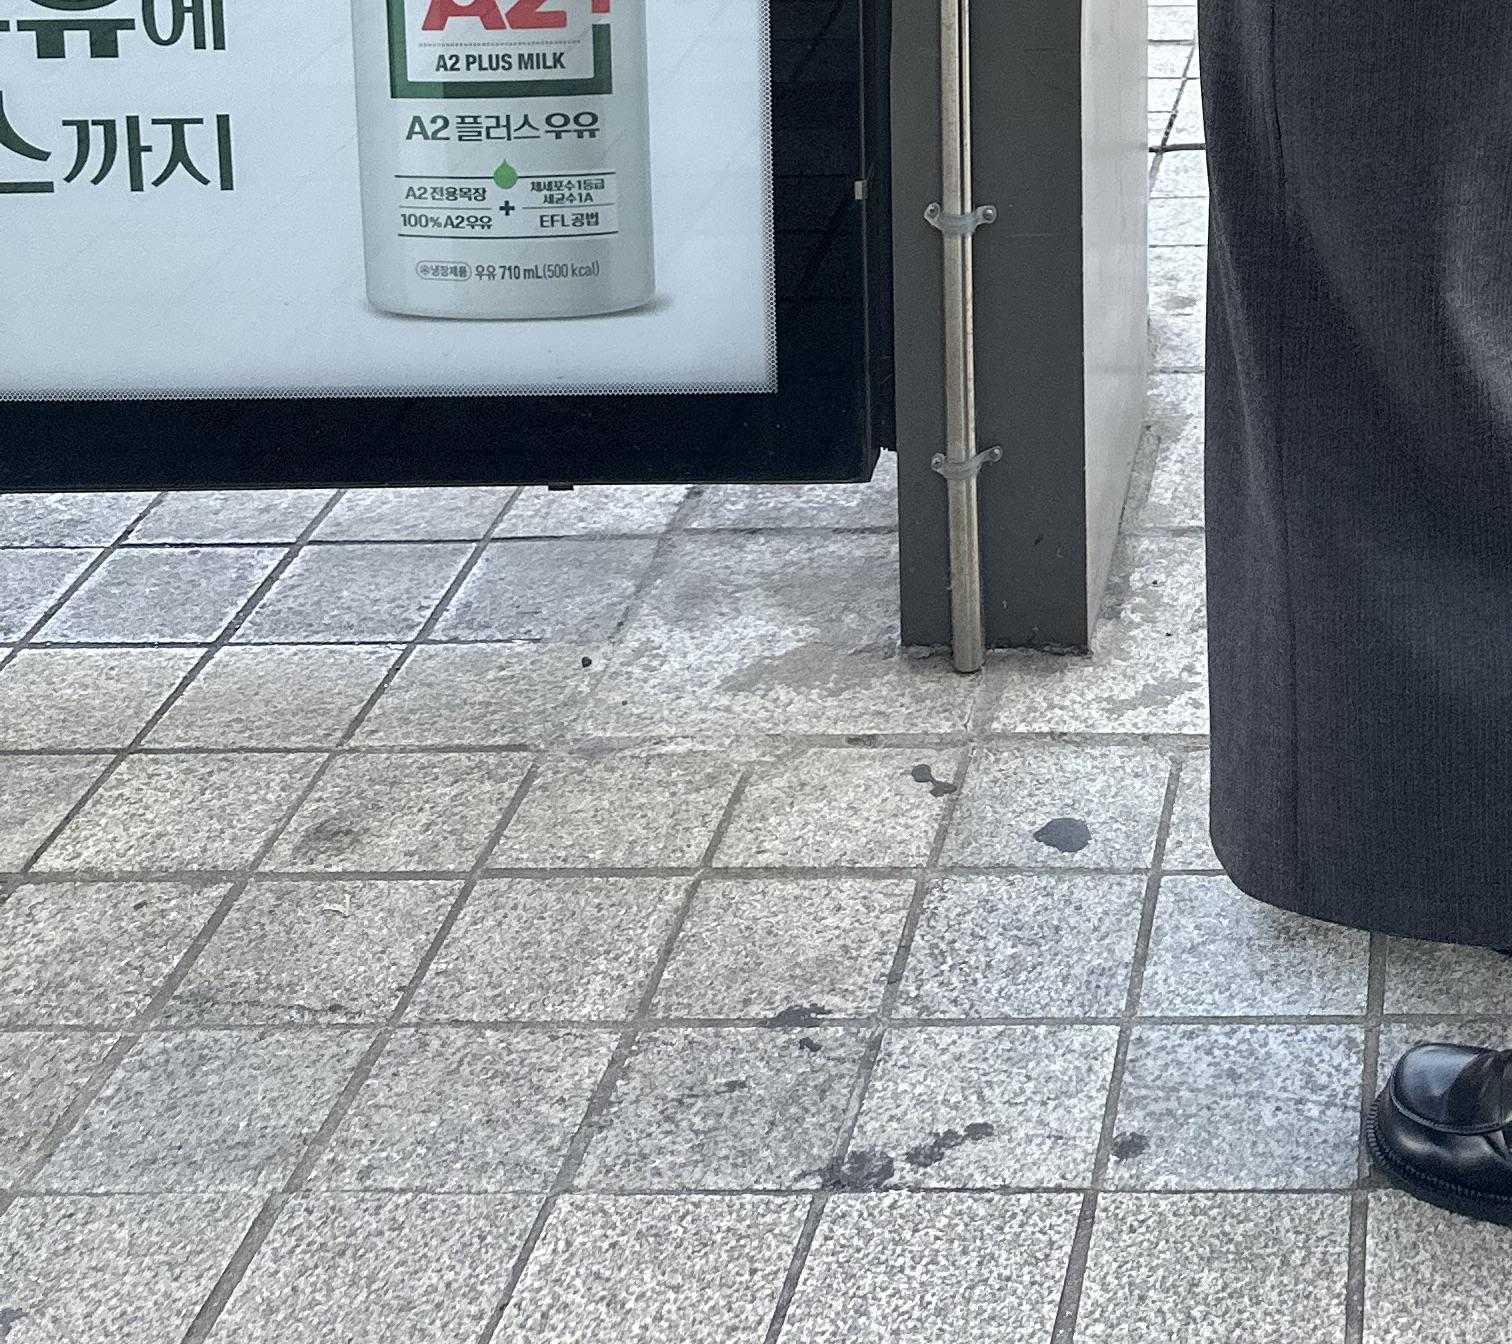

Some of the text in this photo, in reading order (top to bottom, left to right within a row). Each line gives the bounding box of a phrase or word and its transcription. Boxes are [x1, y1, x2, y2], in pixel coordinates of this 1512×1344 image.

[435, 51, 566, 72] A2 PLUS MILK
[475, 264, 497, 281] 우유
[500, 265, 521, 280] 710
